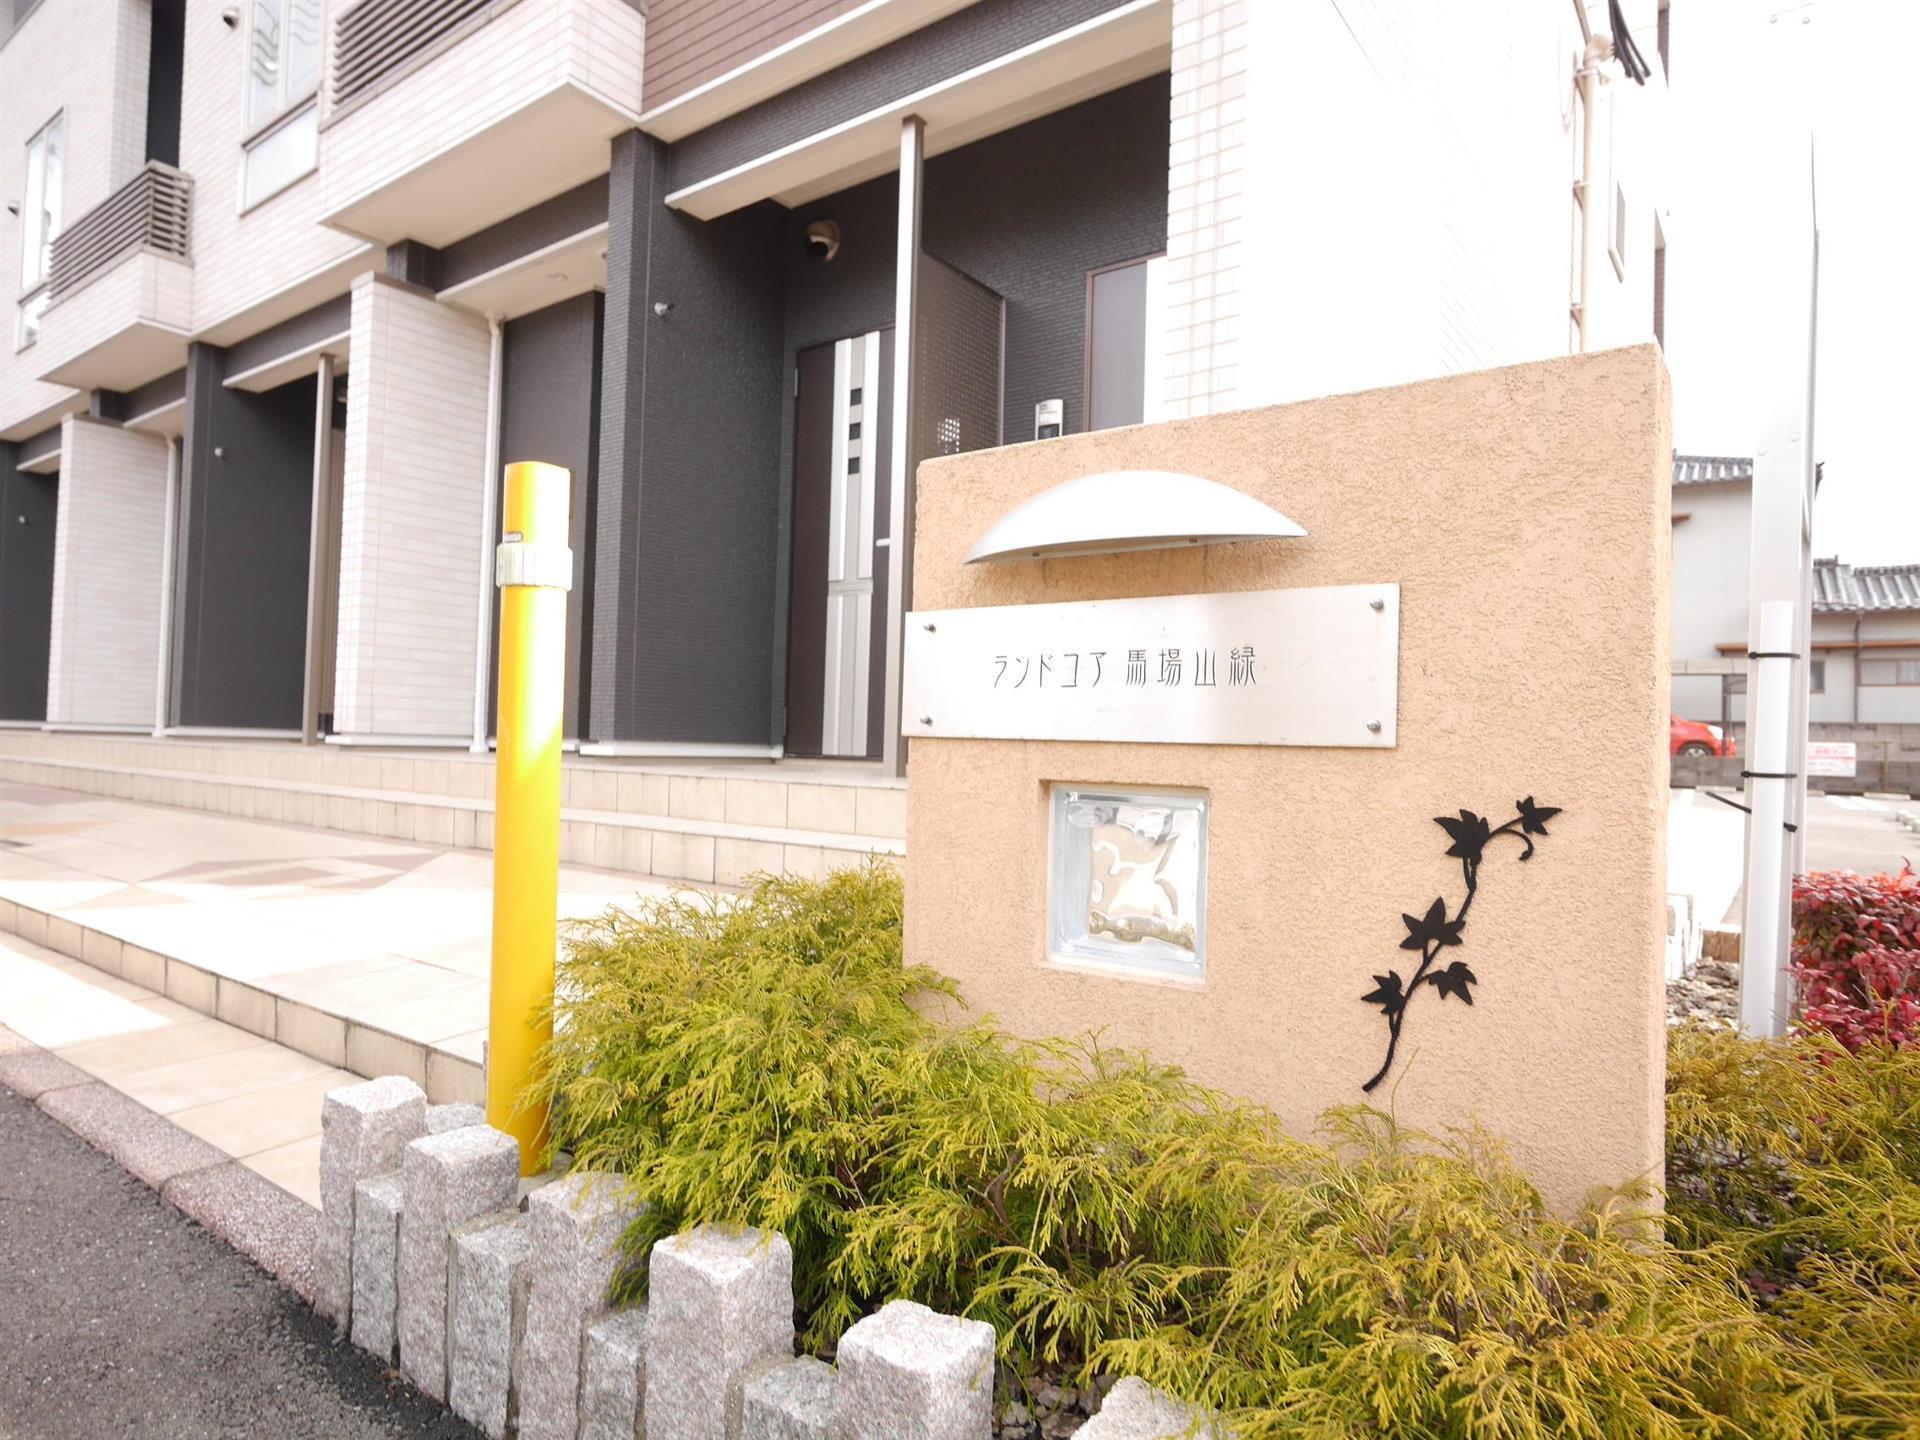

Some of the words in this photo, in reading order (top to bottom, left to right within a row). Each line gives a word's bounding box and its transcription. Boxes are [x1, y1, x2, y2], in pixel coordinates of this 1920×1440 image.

[994, 651, 1107, 688] ランドコア
[1126, 646, 1256, 687] 馬場山緑
